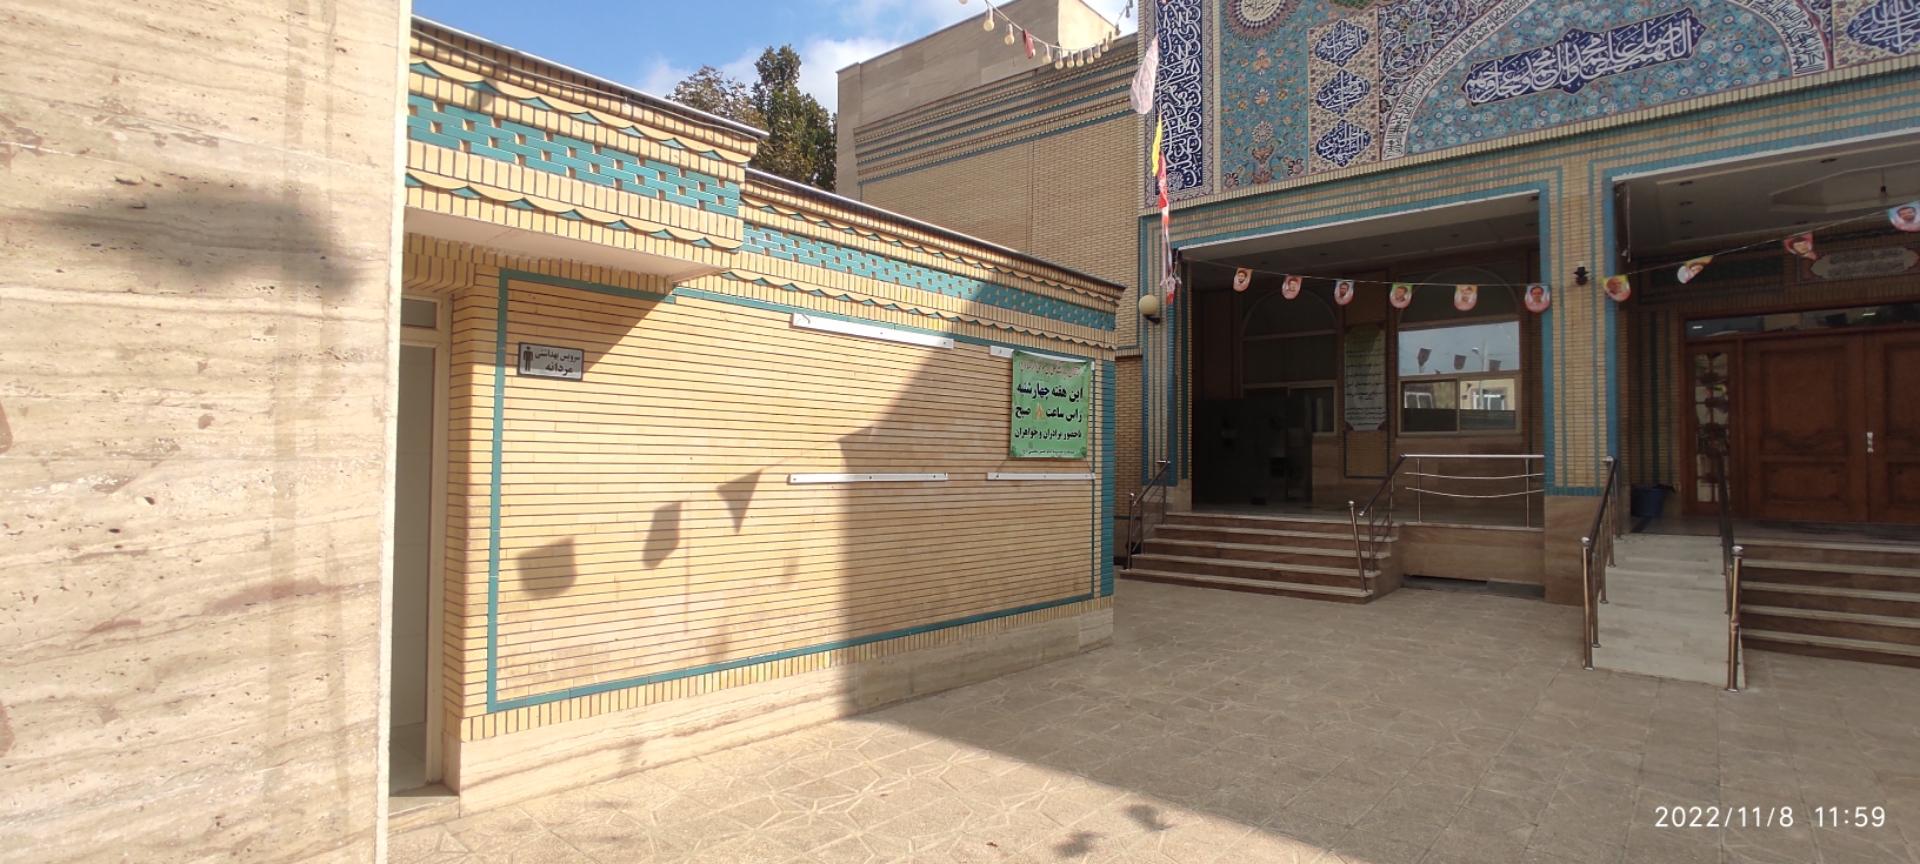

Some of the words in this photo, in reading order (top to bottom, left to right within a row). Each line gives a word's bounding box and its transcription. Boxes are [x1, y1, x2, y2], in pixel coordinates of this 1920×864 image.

[535, 348, 559, 361] بهداشتی
[560, 352, 581, 363] سرویس
[545, 361, 573, 376] مردانه
[1016, 382, 1050, 400] چهارشنبه
[1051, 384, 1067, 397] هفته
[1069, 386, 1083, 402] این
[1015, 406, 1031, 419] صبح
[1045, 406, 1064, 418] ساعت
[1065, 407, 1082, 422] راس
[1014, 427, 1038, 439] خواهران
[1043, 428, 1061, 440] برادران
